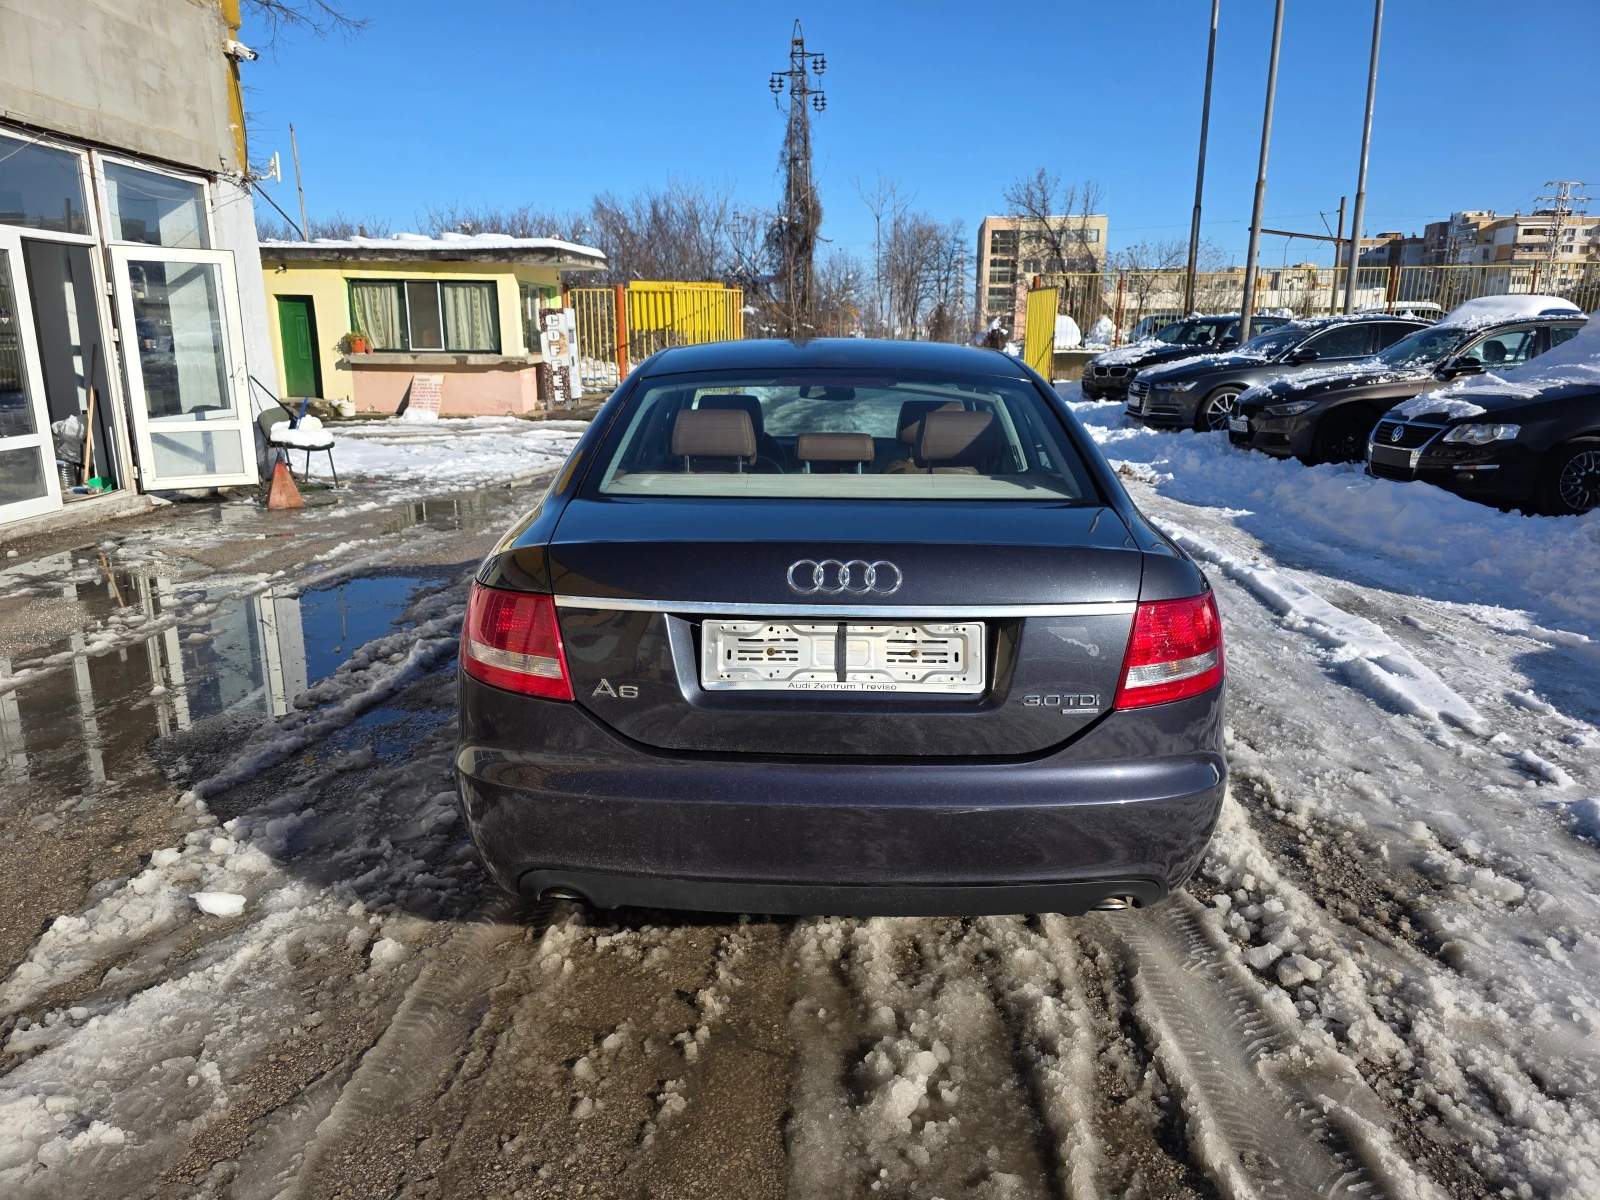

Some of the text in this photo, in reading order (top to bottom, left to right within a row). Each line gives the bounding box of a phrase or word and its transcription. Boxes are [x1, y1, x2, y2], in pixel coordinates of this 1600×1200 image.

[545, 314, 565, 402] COFFEE
[591, 678, 638, 698] A6
[813, 682, 856, 690] Zentrum
[861, 683, 897, 691] Treviso
[1022, 694, 1100, 706] 3.0 TDI
